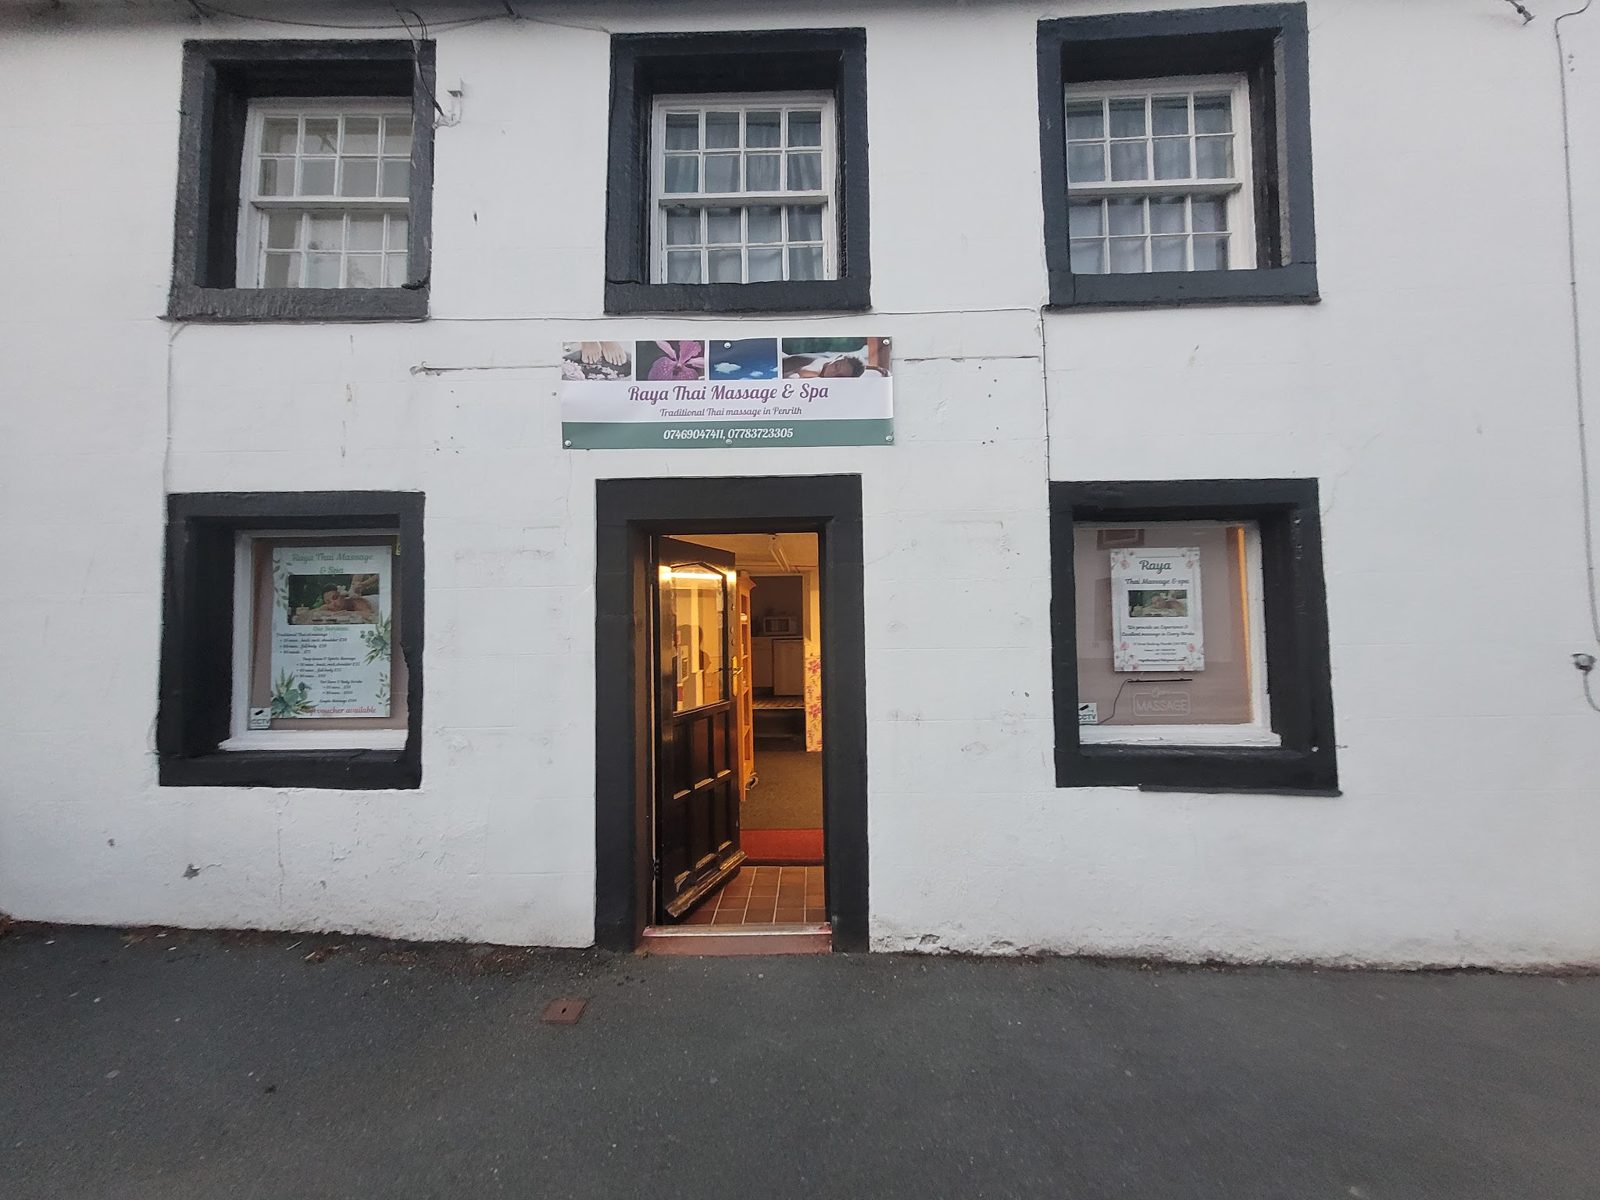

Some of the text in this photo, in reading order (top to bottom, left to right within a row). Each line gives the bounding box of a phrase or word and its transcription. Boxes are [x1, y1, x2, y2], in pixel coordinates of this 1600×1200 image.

[628, 382, 829, 406] Raya Thai Massage & Spa
[660, 405, 803, 418] Traditional Thai massage in Penrith
[1138, 559, 1172, 575] Raya
[1142, 577, 1170, 587] Massage
[345, 704, 377, 714] available
[1136, 699, 1188, 713] MASSAGE
